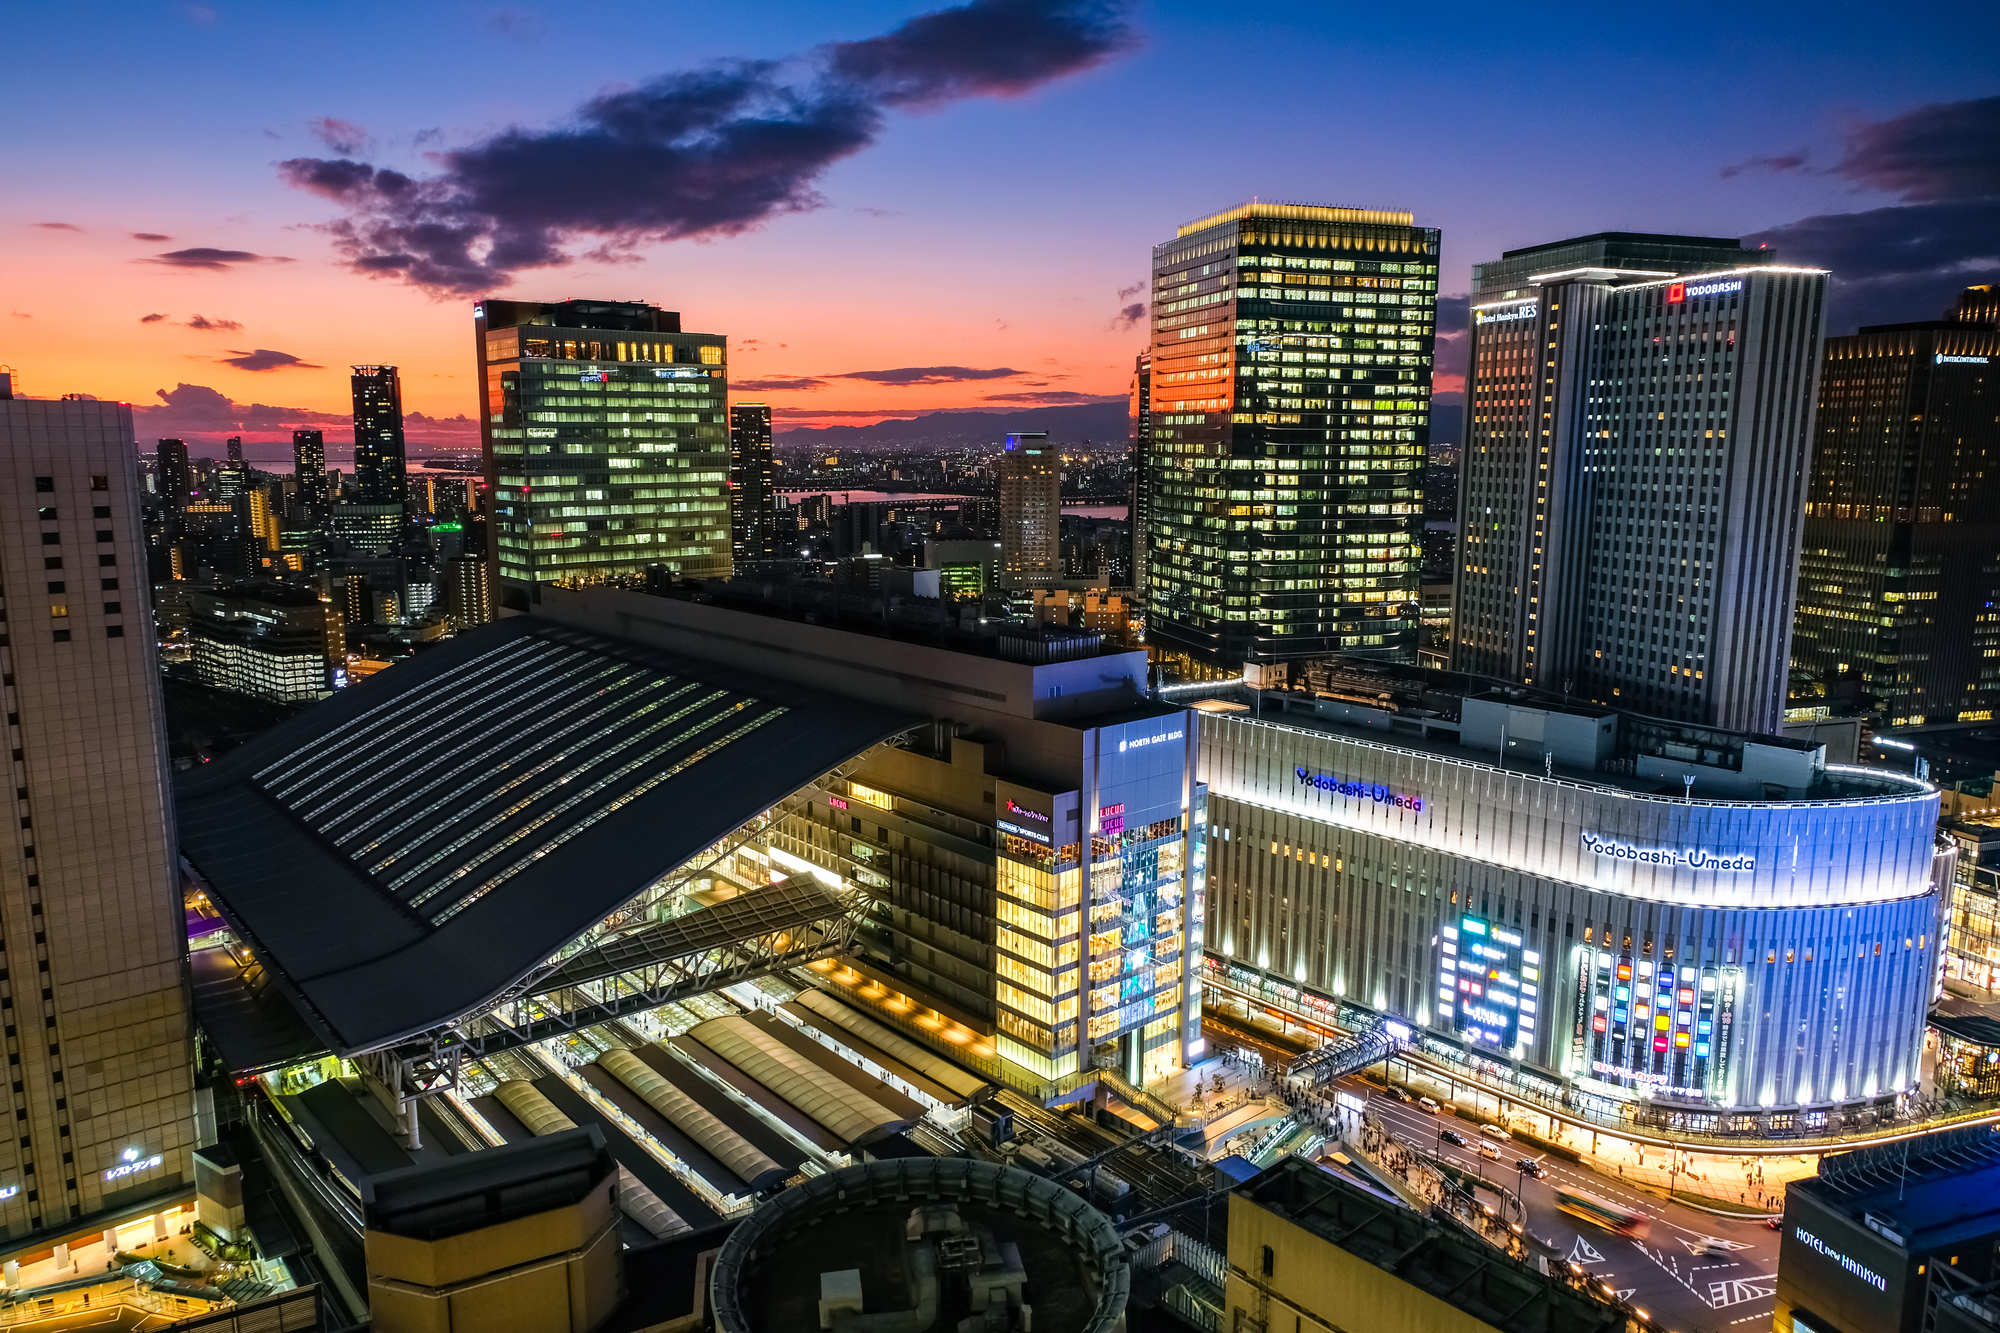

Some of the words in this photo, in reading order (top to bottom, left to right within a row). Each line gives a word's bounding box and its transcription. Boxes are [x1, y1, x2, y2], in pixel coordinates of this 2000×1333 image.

[1686, 281, 1742, 297] YODOBASHI
[1482, 314, 1496, 323] Hotel
[1497, 312, 1518, 322] Hankyu
[1519, 304, 1537, 319] RES
[1129, 737, 1150, 749] NORTH
[1151, 734, 1167, 744] GATE
[1296, 767, 1422, 812] Yodobashi-Umeda
[1020, 828, 1036, 839] SPORTS
[1037, 834, 1049, 842] CLUB
[1582, 834, 1755, 870] Yodobashi-Umeda
[1593, 1061, 1668, 1085] ヨドバシカメラ
[1796, 1226, 1824, 1255] HOTEL
[1825, 1245, 1840, 1261] new
[1841, 1254, 1887, 1291] HANKYU
